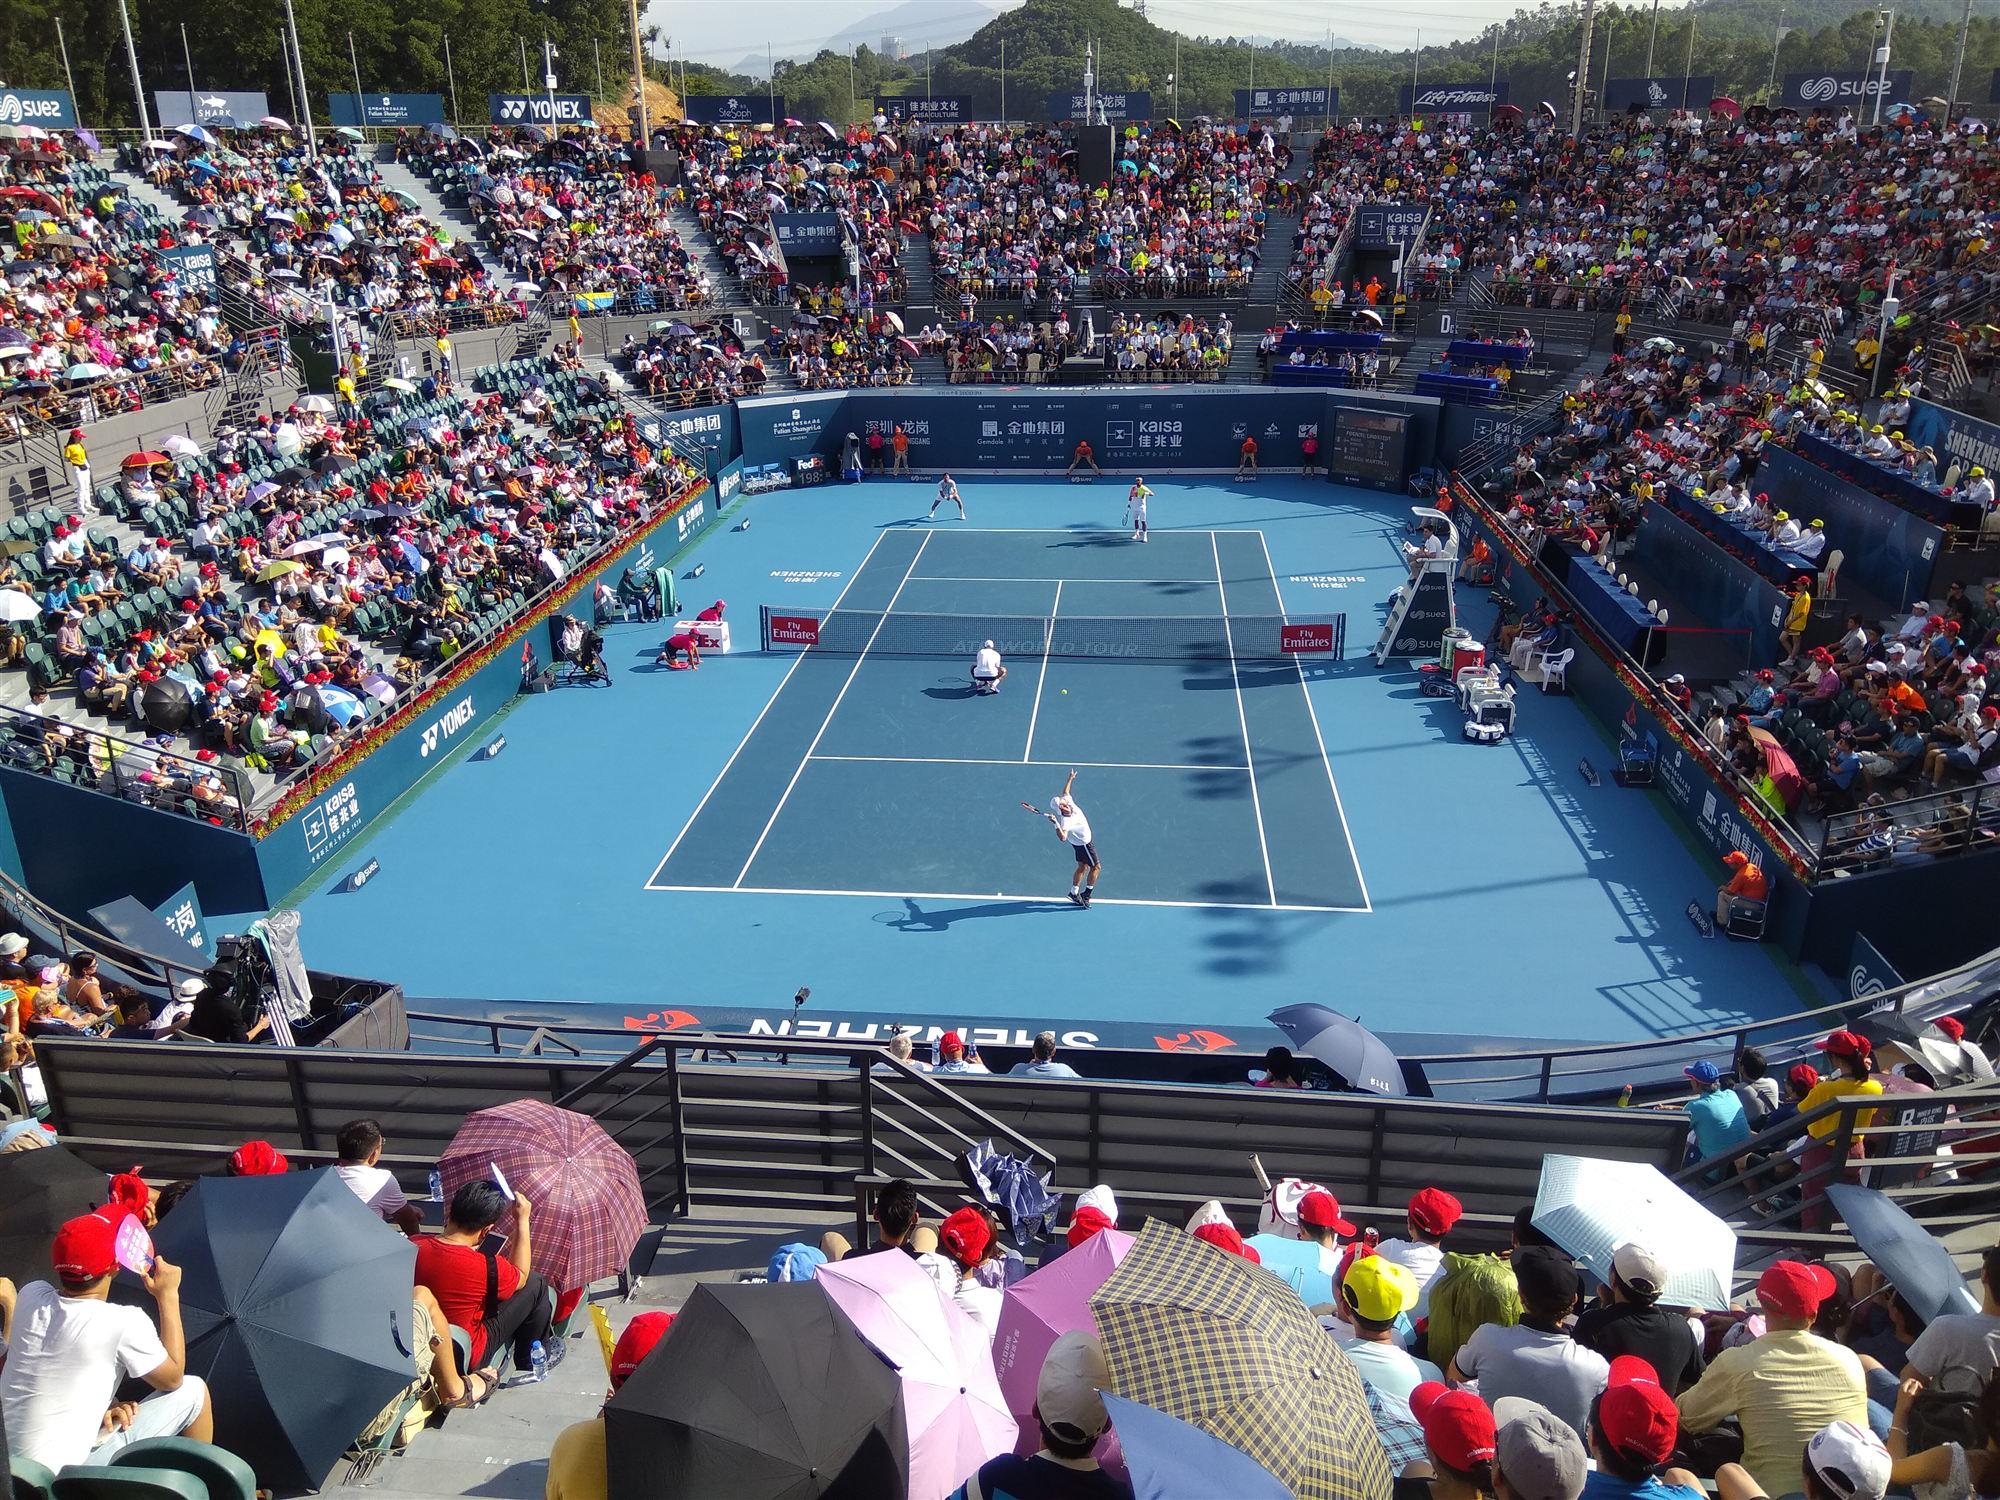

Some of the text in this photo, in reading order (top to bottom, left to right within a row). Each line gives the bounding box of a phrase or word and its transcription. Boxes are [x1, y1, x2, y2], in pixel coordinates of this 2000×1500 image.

[1103, 95, 1126, 107] 龙岗
[1277, 91, 1324, 103] 金地集团
[531, 101, 579, 118] YONEX
[910, 101, 958, 111] 佳兆业文化
[796, 226, 836, 237] 金地集团
[667, 414, 721, 437] 金地集团
[902, 420, 928, 434] 龙岗
[1008, 421, 1064, 434] 金地集团
[1139, 421, 1182, 432] Kaisa
[1138, 435, 1182, 447] 佳兆业
[798, 457, 824, 470] FedEx
[788, 621, 801, 630] Fly
[773, 628, 816, 640] Emirates
[1300, 629, 1313, 638] Fly
[1284, 637, 1330, 648] Emirates
[439, 695, 473, 739] YONEX
[325, 782, 356, 815] Kaisa
[328, 799, 359, 833] 佳兆业
[1719, 811, 1763, 869] 金地集团
